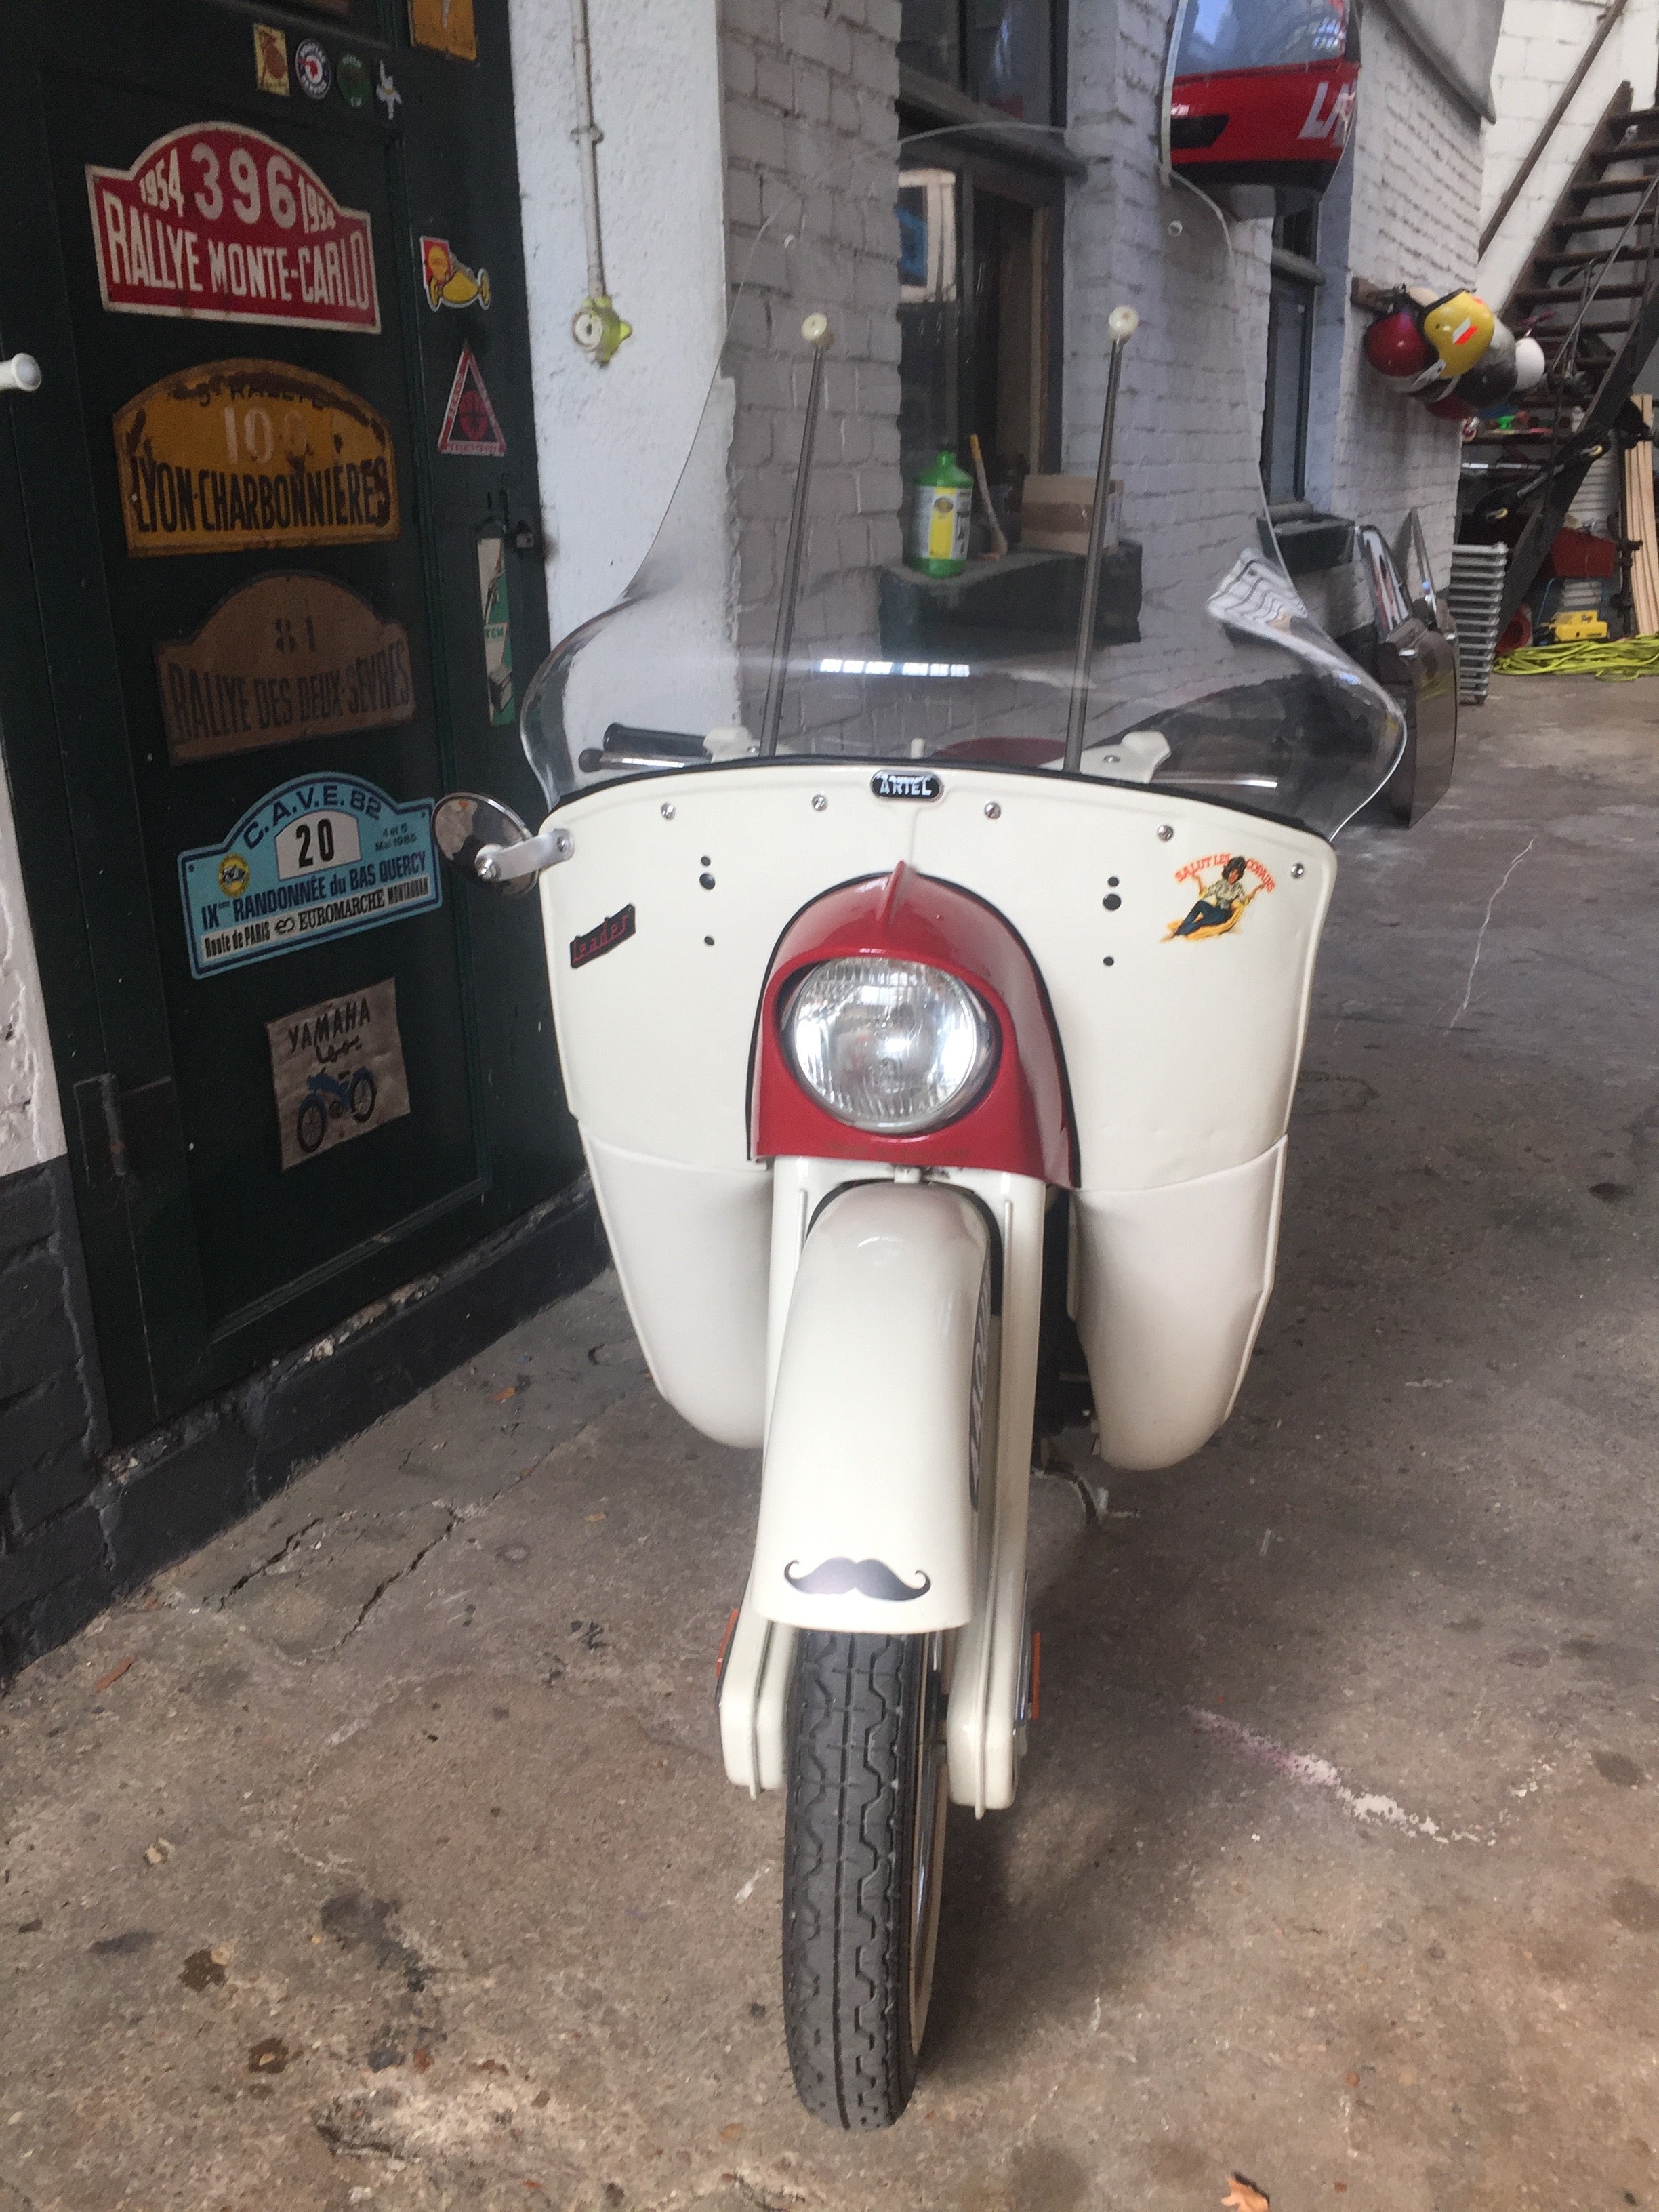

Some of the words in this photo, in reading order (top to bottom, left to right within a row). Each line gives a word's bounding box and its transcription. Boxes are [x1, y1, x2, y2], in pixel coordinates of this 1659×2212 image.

[140, 148, 184, 218] 1954
[191, 142, 296, 229] 396
[298, 174, 336, 234] 1954
[102, 190, 203, 293] RALLYE
[207, 230, 370, 310] MONTE-CARLO
[169, 661, 252, 740] RALLYE
[252, 678, 293, 729] DES
[295, 818, 335, 868] 20
[1175, 856, 1211, 883] SALUT
[1246, 857, 1276, 893] COPAINS
[233, 876, 326, 922] RANDONNÉE
[330, 873, 346, 897] du
[349, 863, 376, 890] BAS
[379, 850, 426, 883] QUERCY
[205, 932, 231, 958] Route
[232, 929, 243, 951] de
[245, 920, 270, 947] PARIS
[288, 997, 371, 1054] YAMAHA
